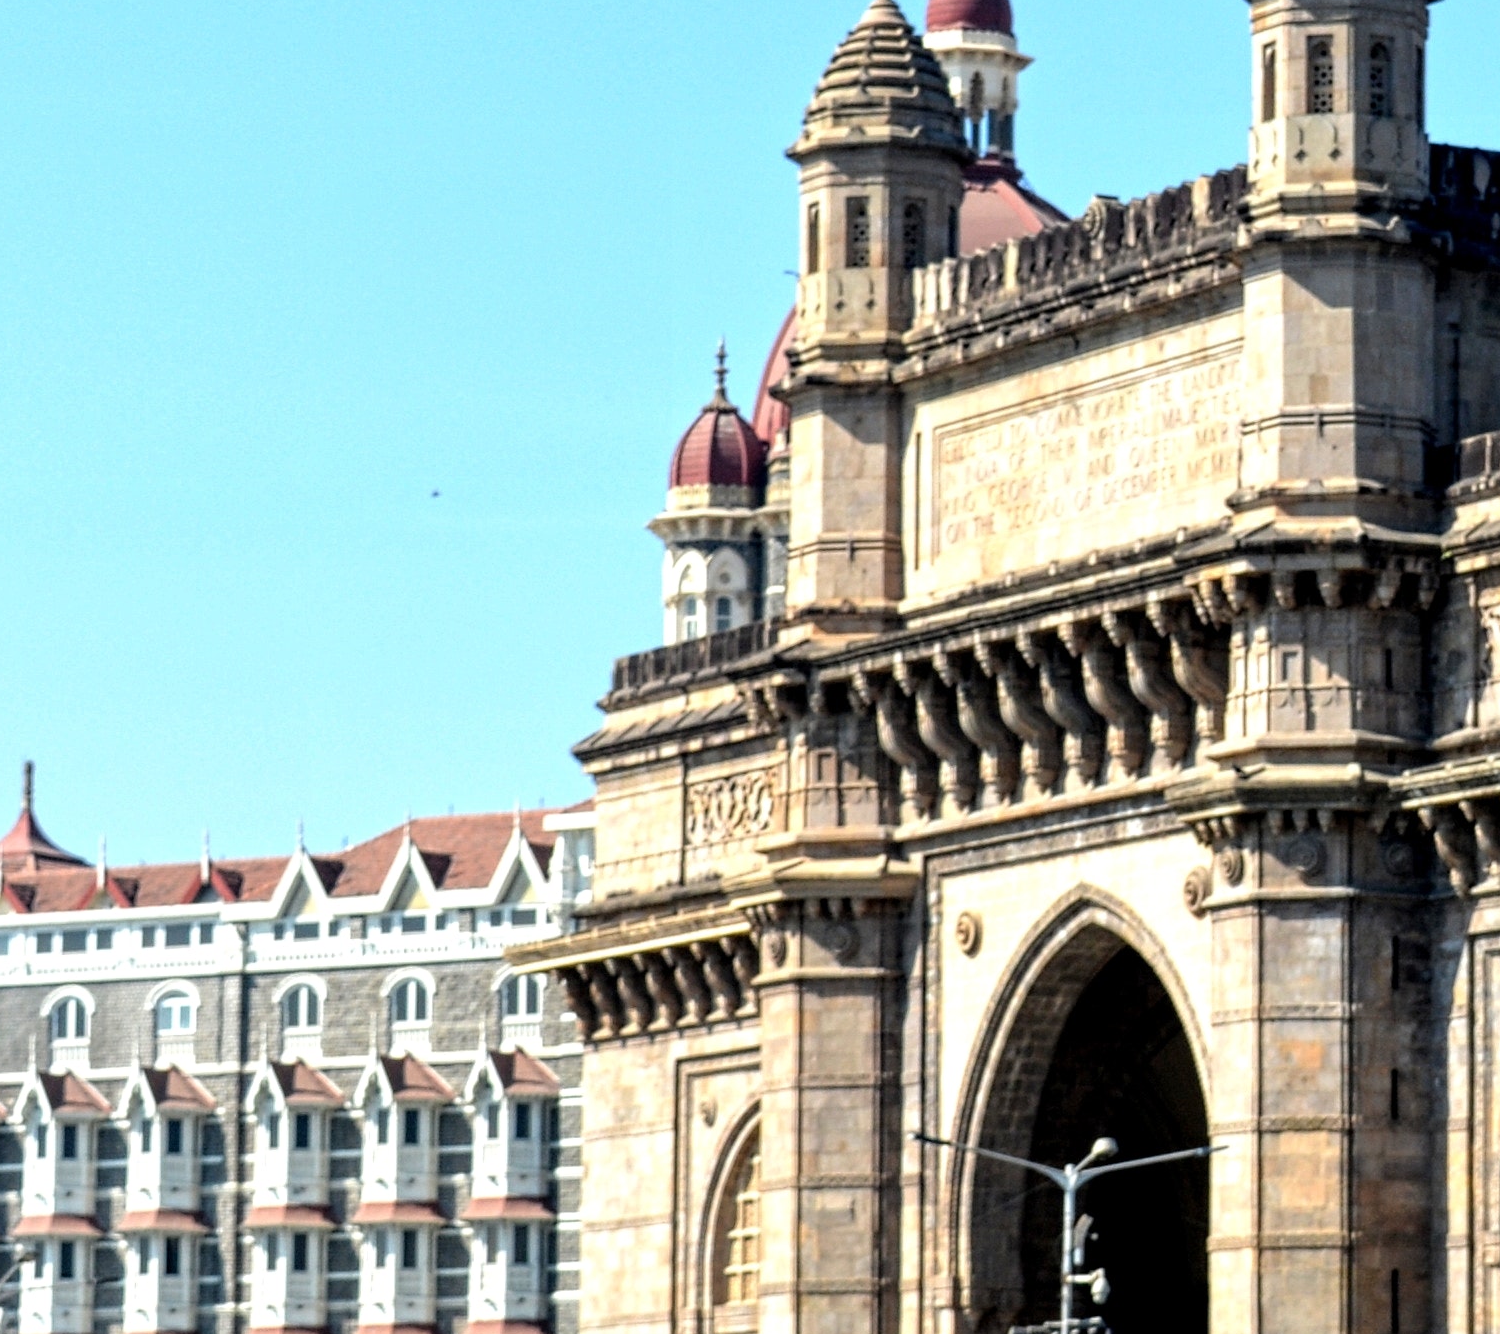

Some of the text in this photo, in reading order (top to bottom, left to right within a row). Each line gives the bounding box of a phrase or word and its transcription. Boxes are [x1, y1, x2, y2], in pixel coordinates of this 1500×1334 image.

[1009, 422, 1029, 449] TO
[1150, 378, 1173, 406] THE
[987, 469, 1049, 508] GEORGE
[1086, 451, 1115, 480] AND
[1129, 435, 1184, 469] QUEEN
[1009, 448, 1026, 473] OF
[945, 520, 968, 545] ON
[973, 511, 997, 538] THE
[1005, 495, 1066, 531] SECOND
[1074, 486, 1094, 512] OF
[1101, 464, 1179, 505] DECEMBER
